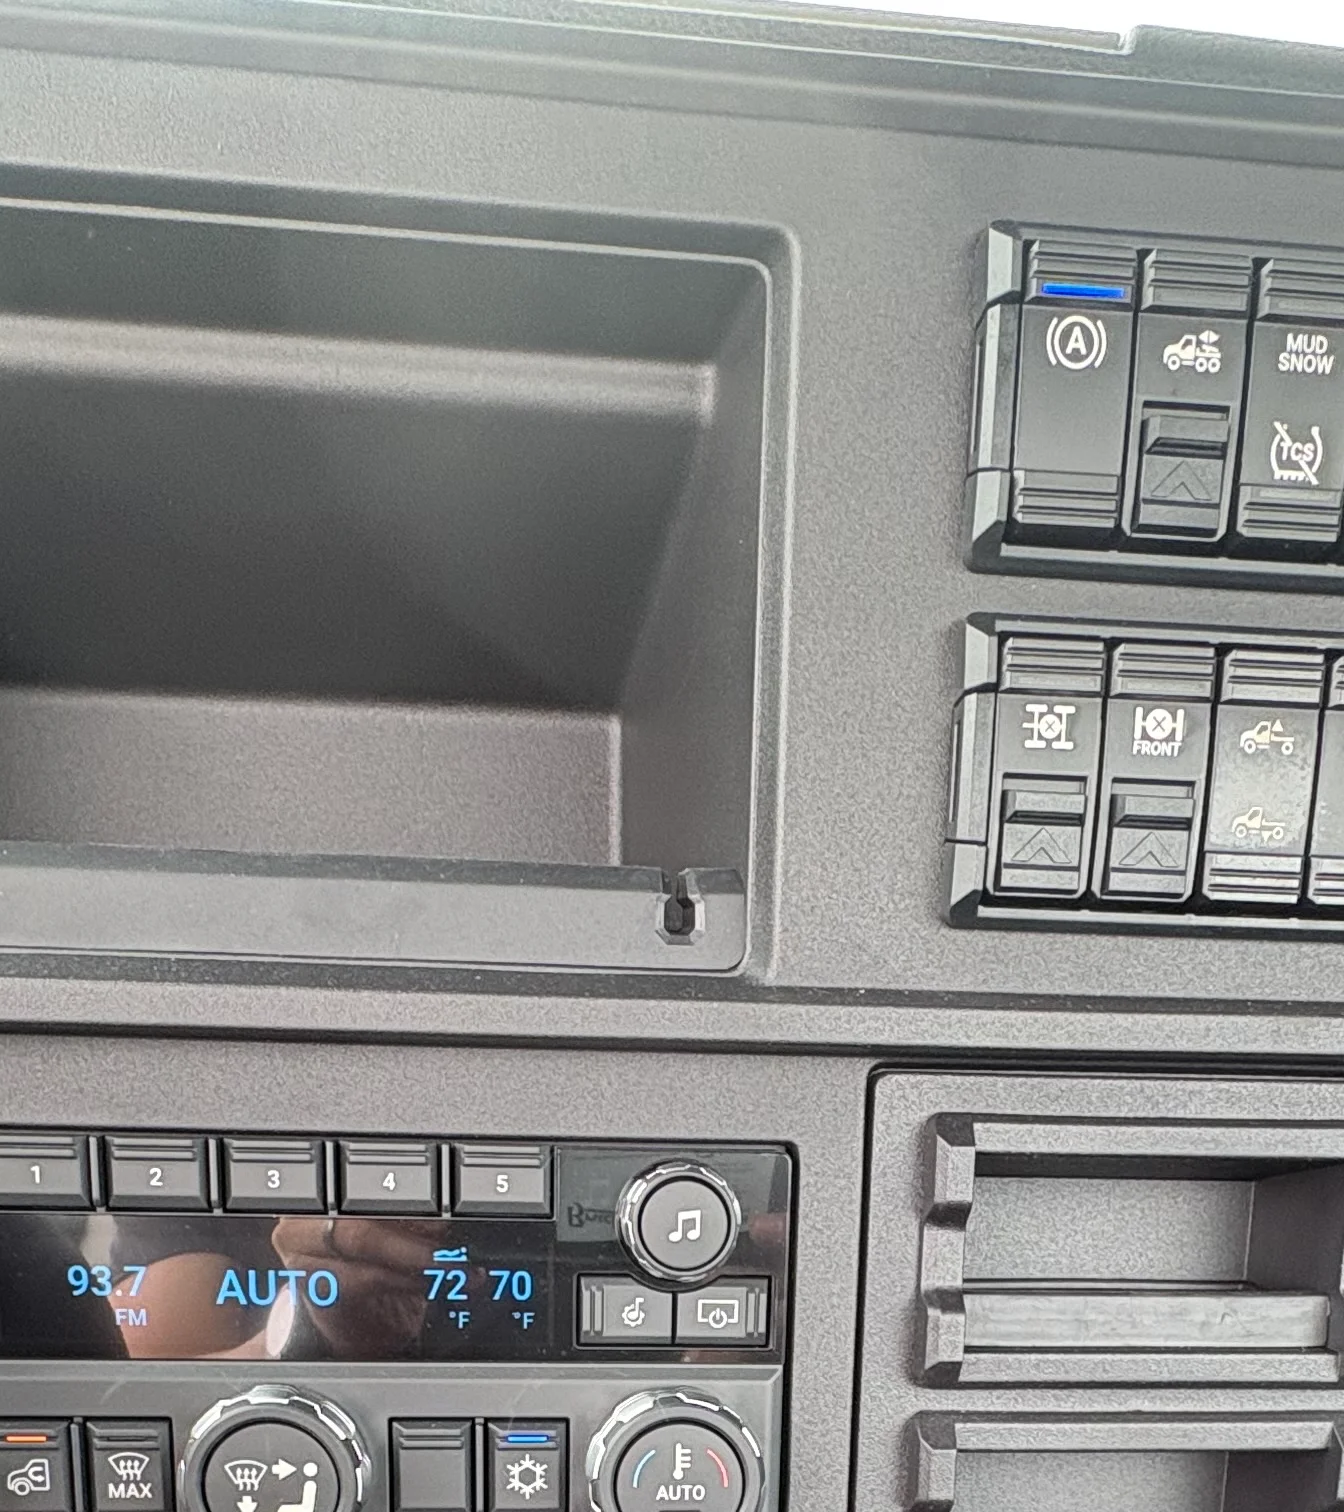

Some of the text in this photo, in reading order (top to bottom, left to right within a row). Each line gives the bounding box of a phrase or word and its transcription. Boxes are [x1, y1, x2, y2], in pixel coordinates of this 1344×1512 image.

[1286, 333, 1329, 354] MUD
[1278, 352, 1335, 375] SNOW
[1280, 441, 1315, 462] TCS
[1133, 740, 1182, 757] FRONT
[30, 1166, 42, 1184] 1
[149, 1167, 164, 1187] 2
[267, 1170, 281, 1189] 3
[382, 1172, 397, 1191] 4
[496, 1175, 509, 1193] 5
[66, 1264, 148, 1298] 93.7
[216, 1270, 338, 1307] AUTO
[423, 1270, 469, 1301] 72
[489, 1270, 533, 1301] 70
[115, 1308, 148, 1327] FM
[107, 1483, 153, 1500] MAX
[656, 1484, 706, 1502] AUTO
